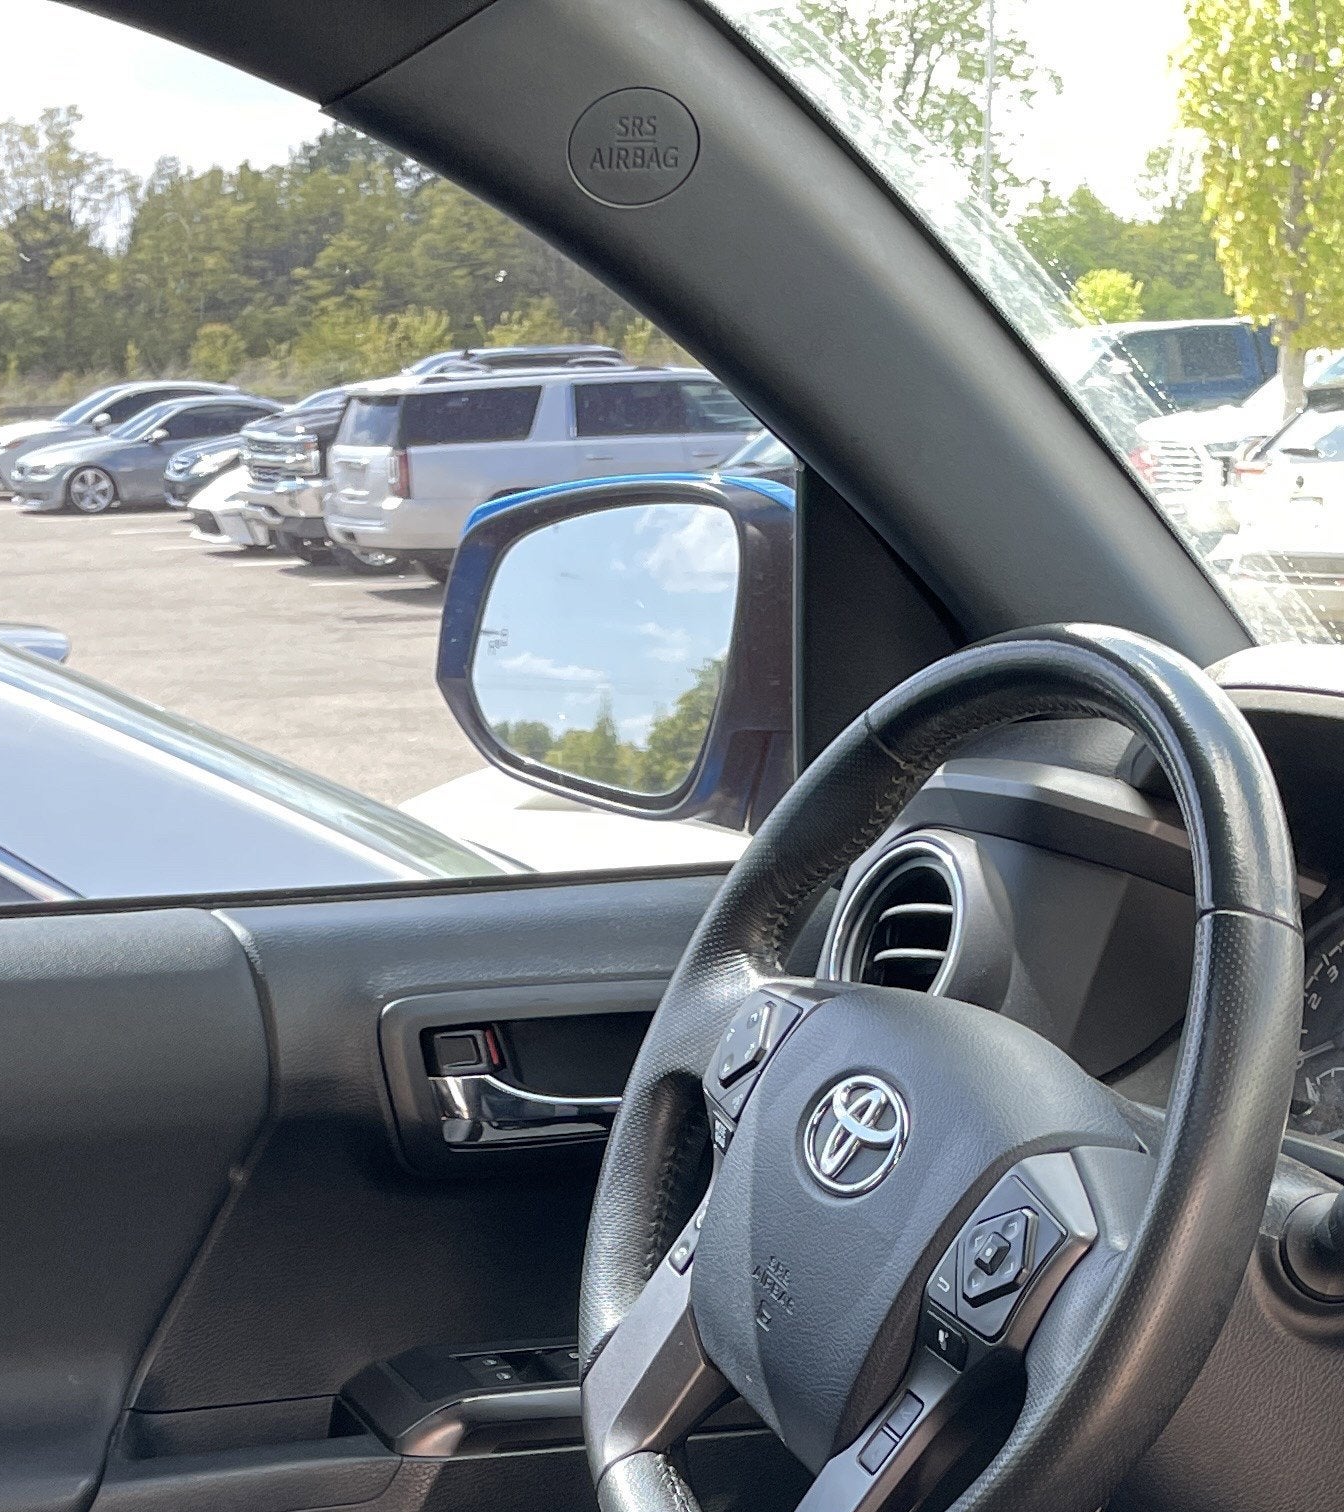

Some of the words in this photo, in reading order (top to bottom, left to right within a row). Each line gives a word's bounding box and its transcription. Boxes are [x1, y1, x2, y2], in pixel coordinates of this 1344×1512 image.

[616, 115, 657, 138] SRS
[589, 146, 679, 170] AIRBAG
[1326, 964, 1339, 984] 3
